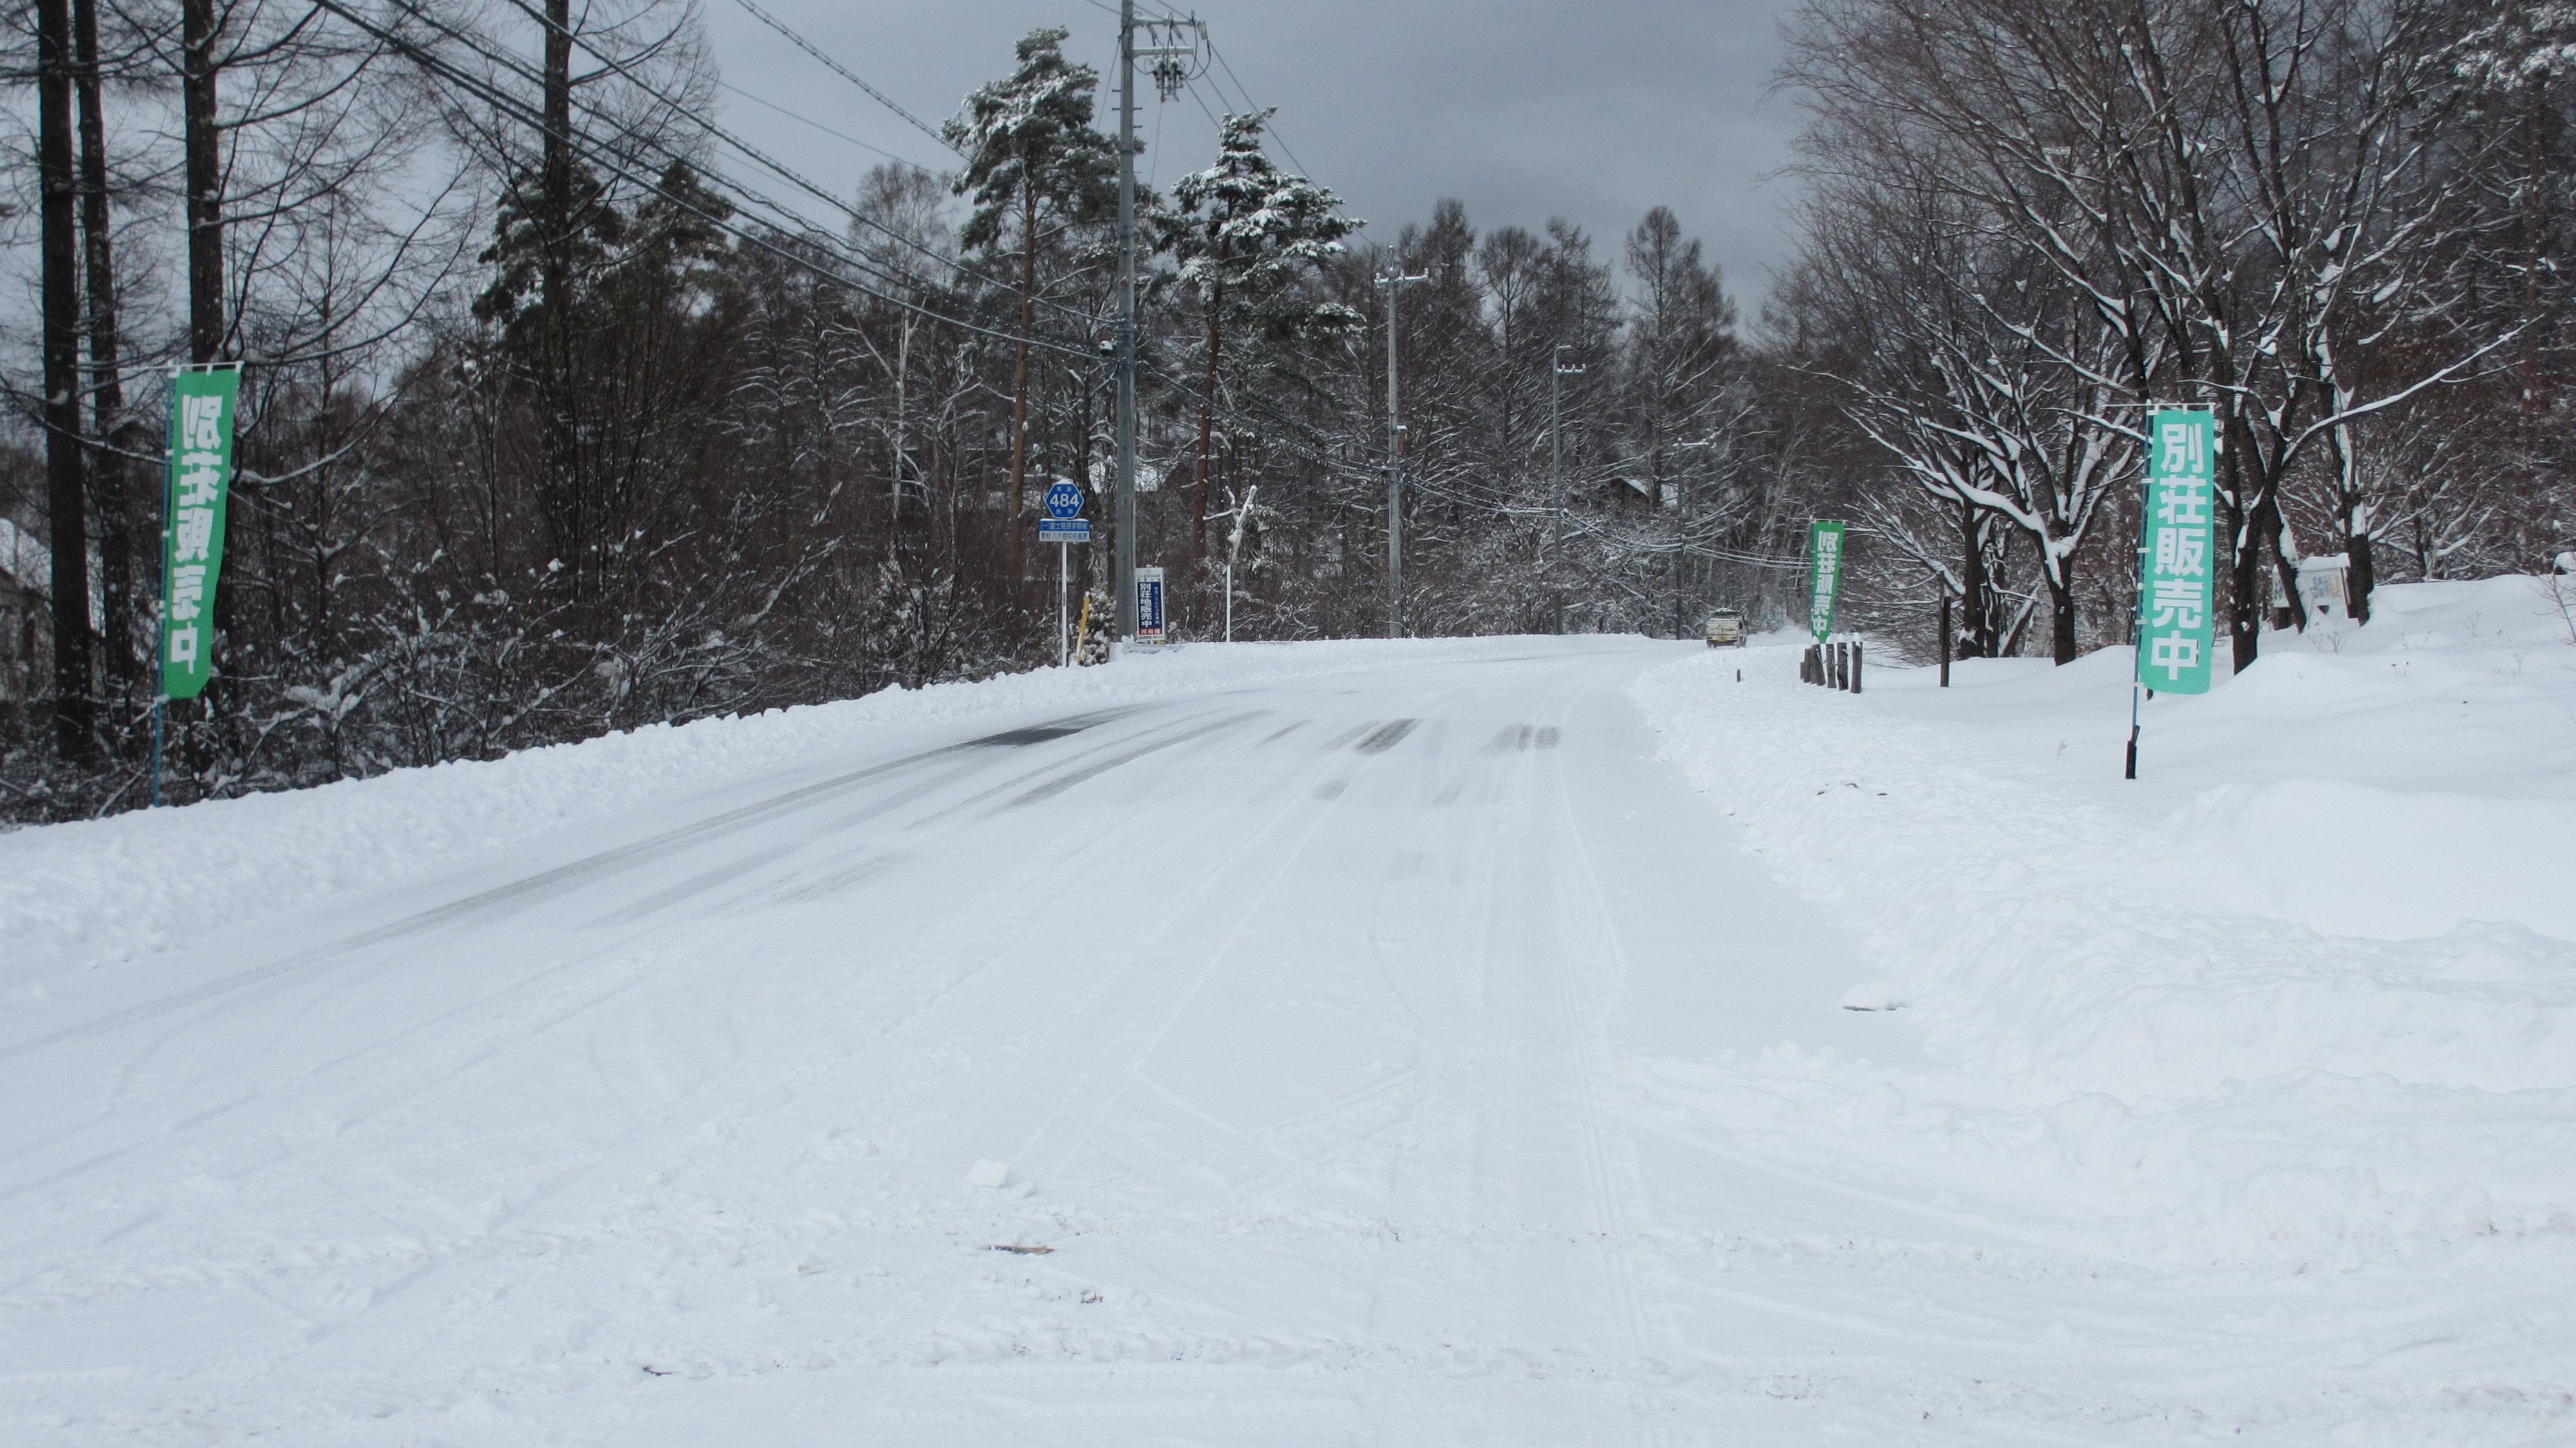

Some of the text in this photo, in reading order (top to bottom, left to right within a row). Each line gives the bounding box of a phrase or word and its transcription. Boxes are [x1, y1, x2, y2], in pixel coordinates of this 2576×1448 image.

[1050, 493, 1079, 508] 484
[2150, 423, 2207, 681] 別荘販売中
[1140, 583, 1152, 627] 別荘地販売中
